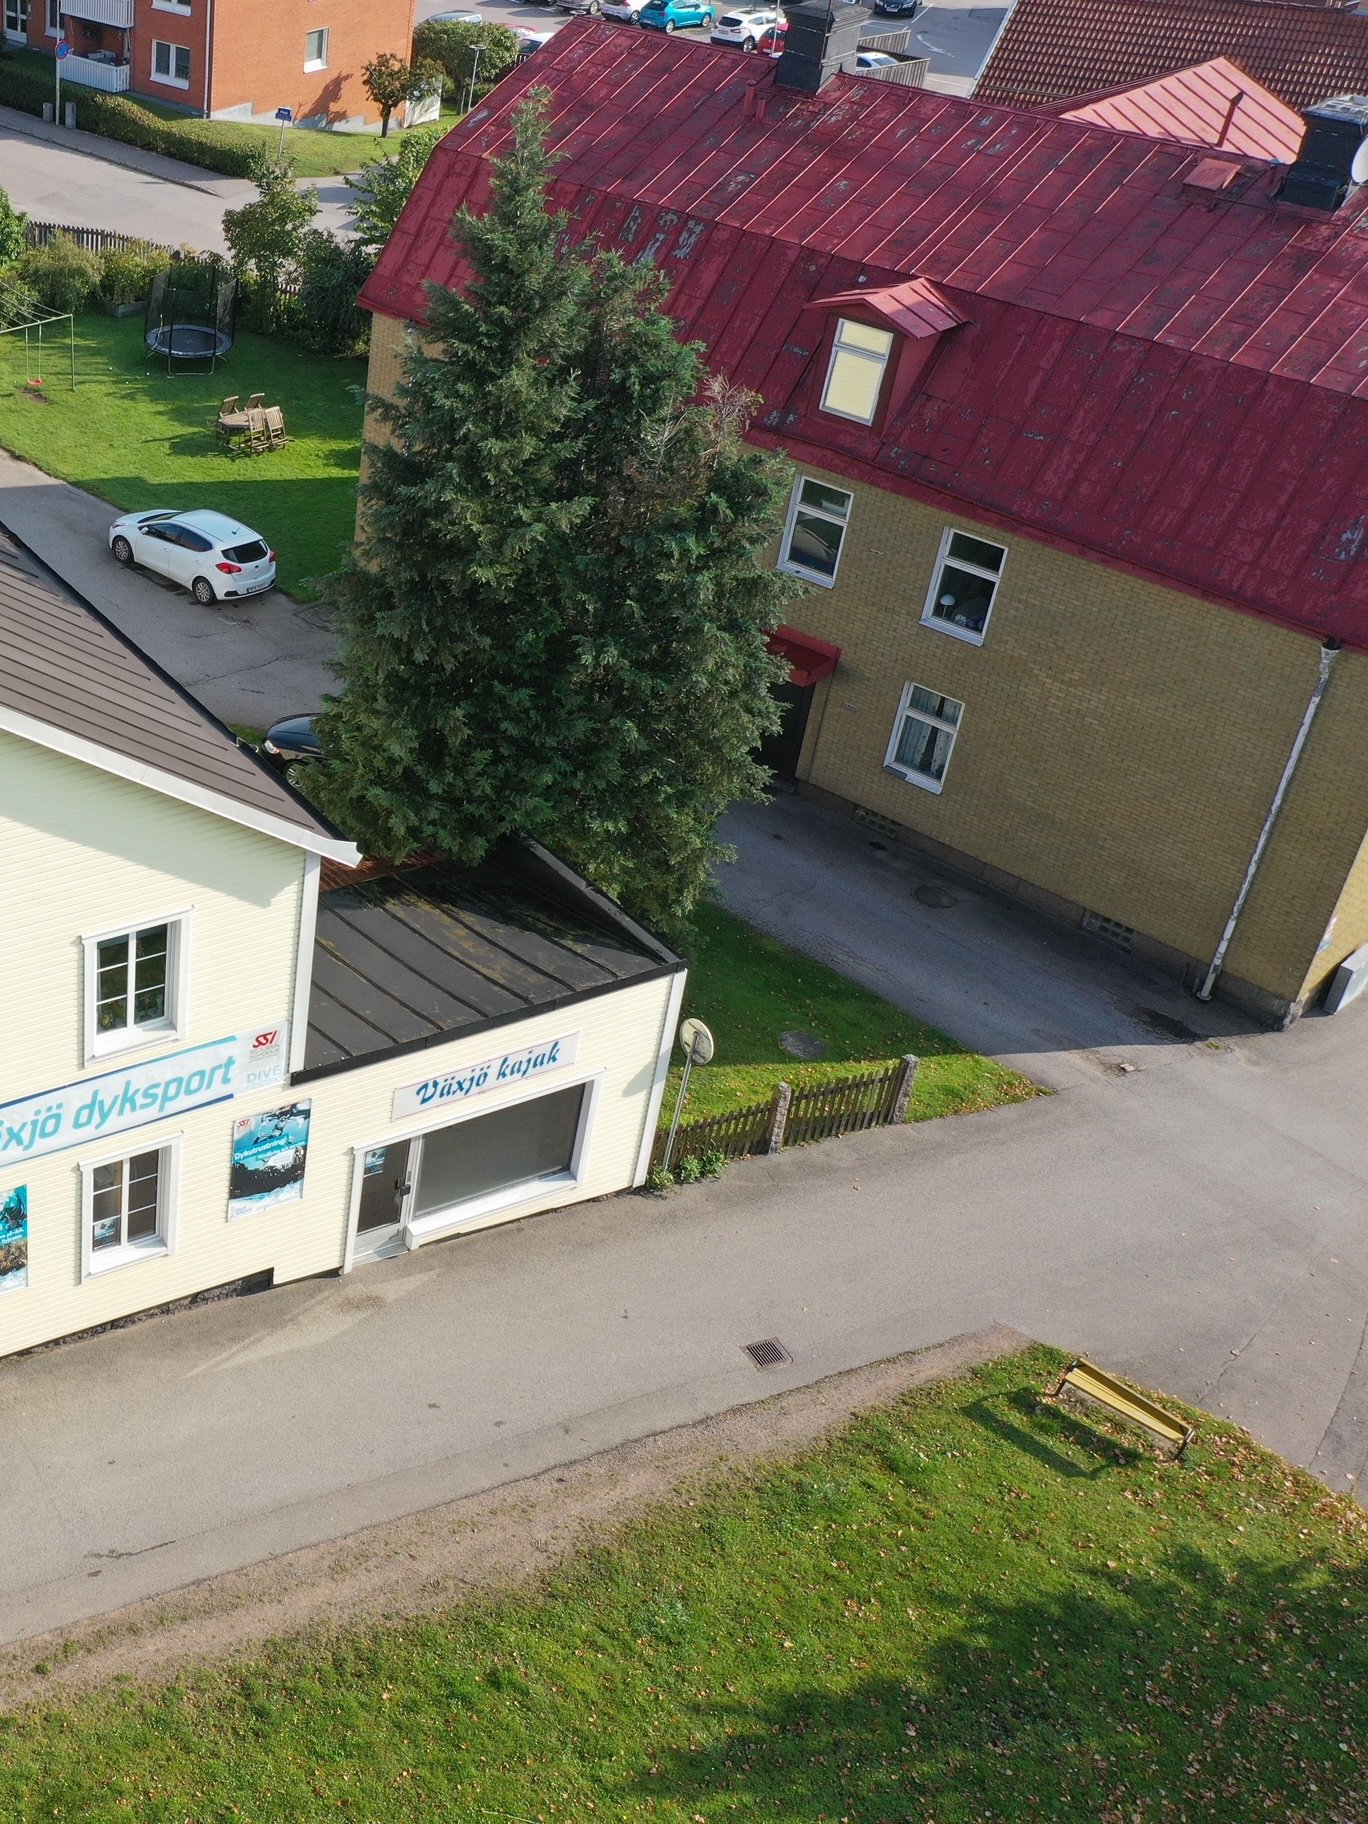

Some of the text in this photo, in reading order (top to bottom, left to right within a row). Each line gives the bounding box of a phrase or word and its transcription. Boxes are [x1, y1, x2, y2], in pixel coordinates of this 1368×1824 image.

[252, 1030, 278, 1048] SSI
[247, 1065, 280, 1083] DIVE
[416, 1041, 560, 1105] Växjö kajak
[72, 1055, 236, 1130] dyksport
[234, 1136, 287, 1160] Dykutrustning!
